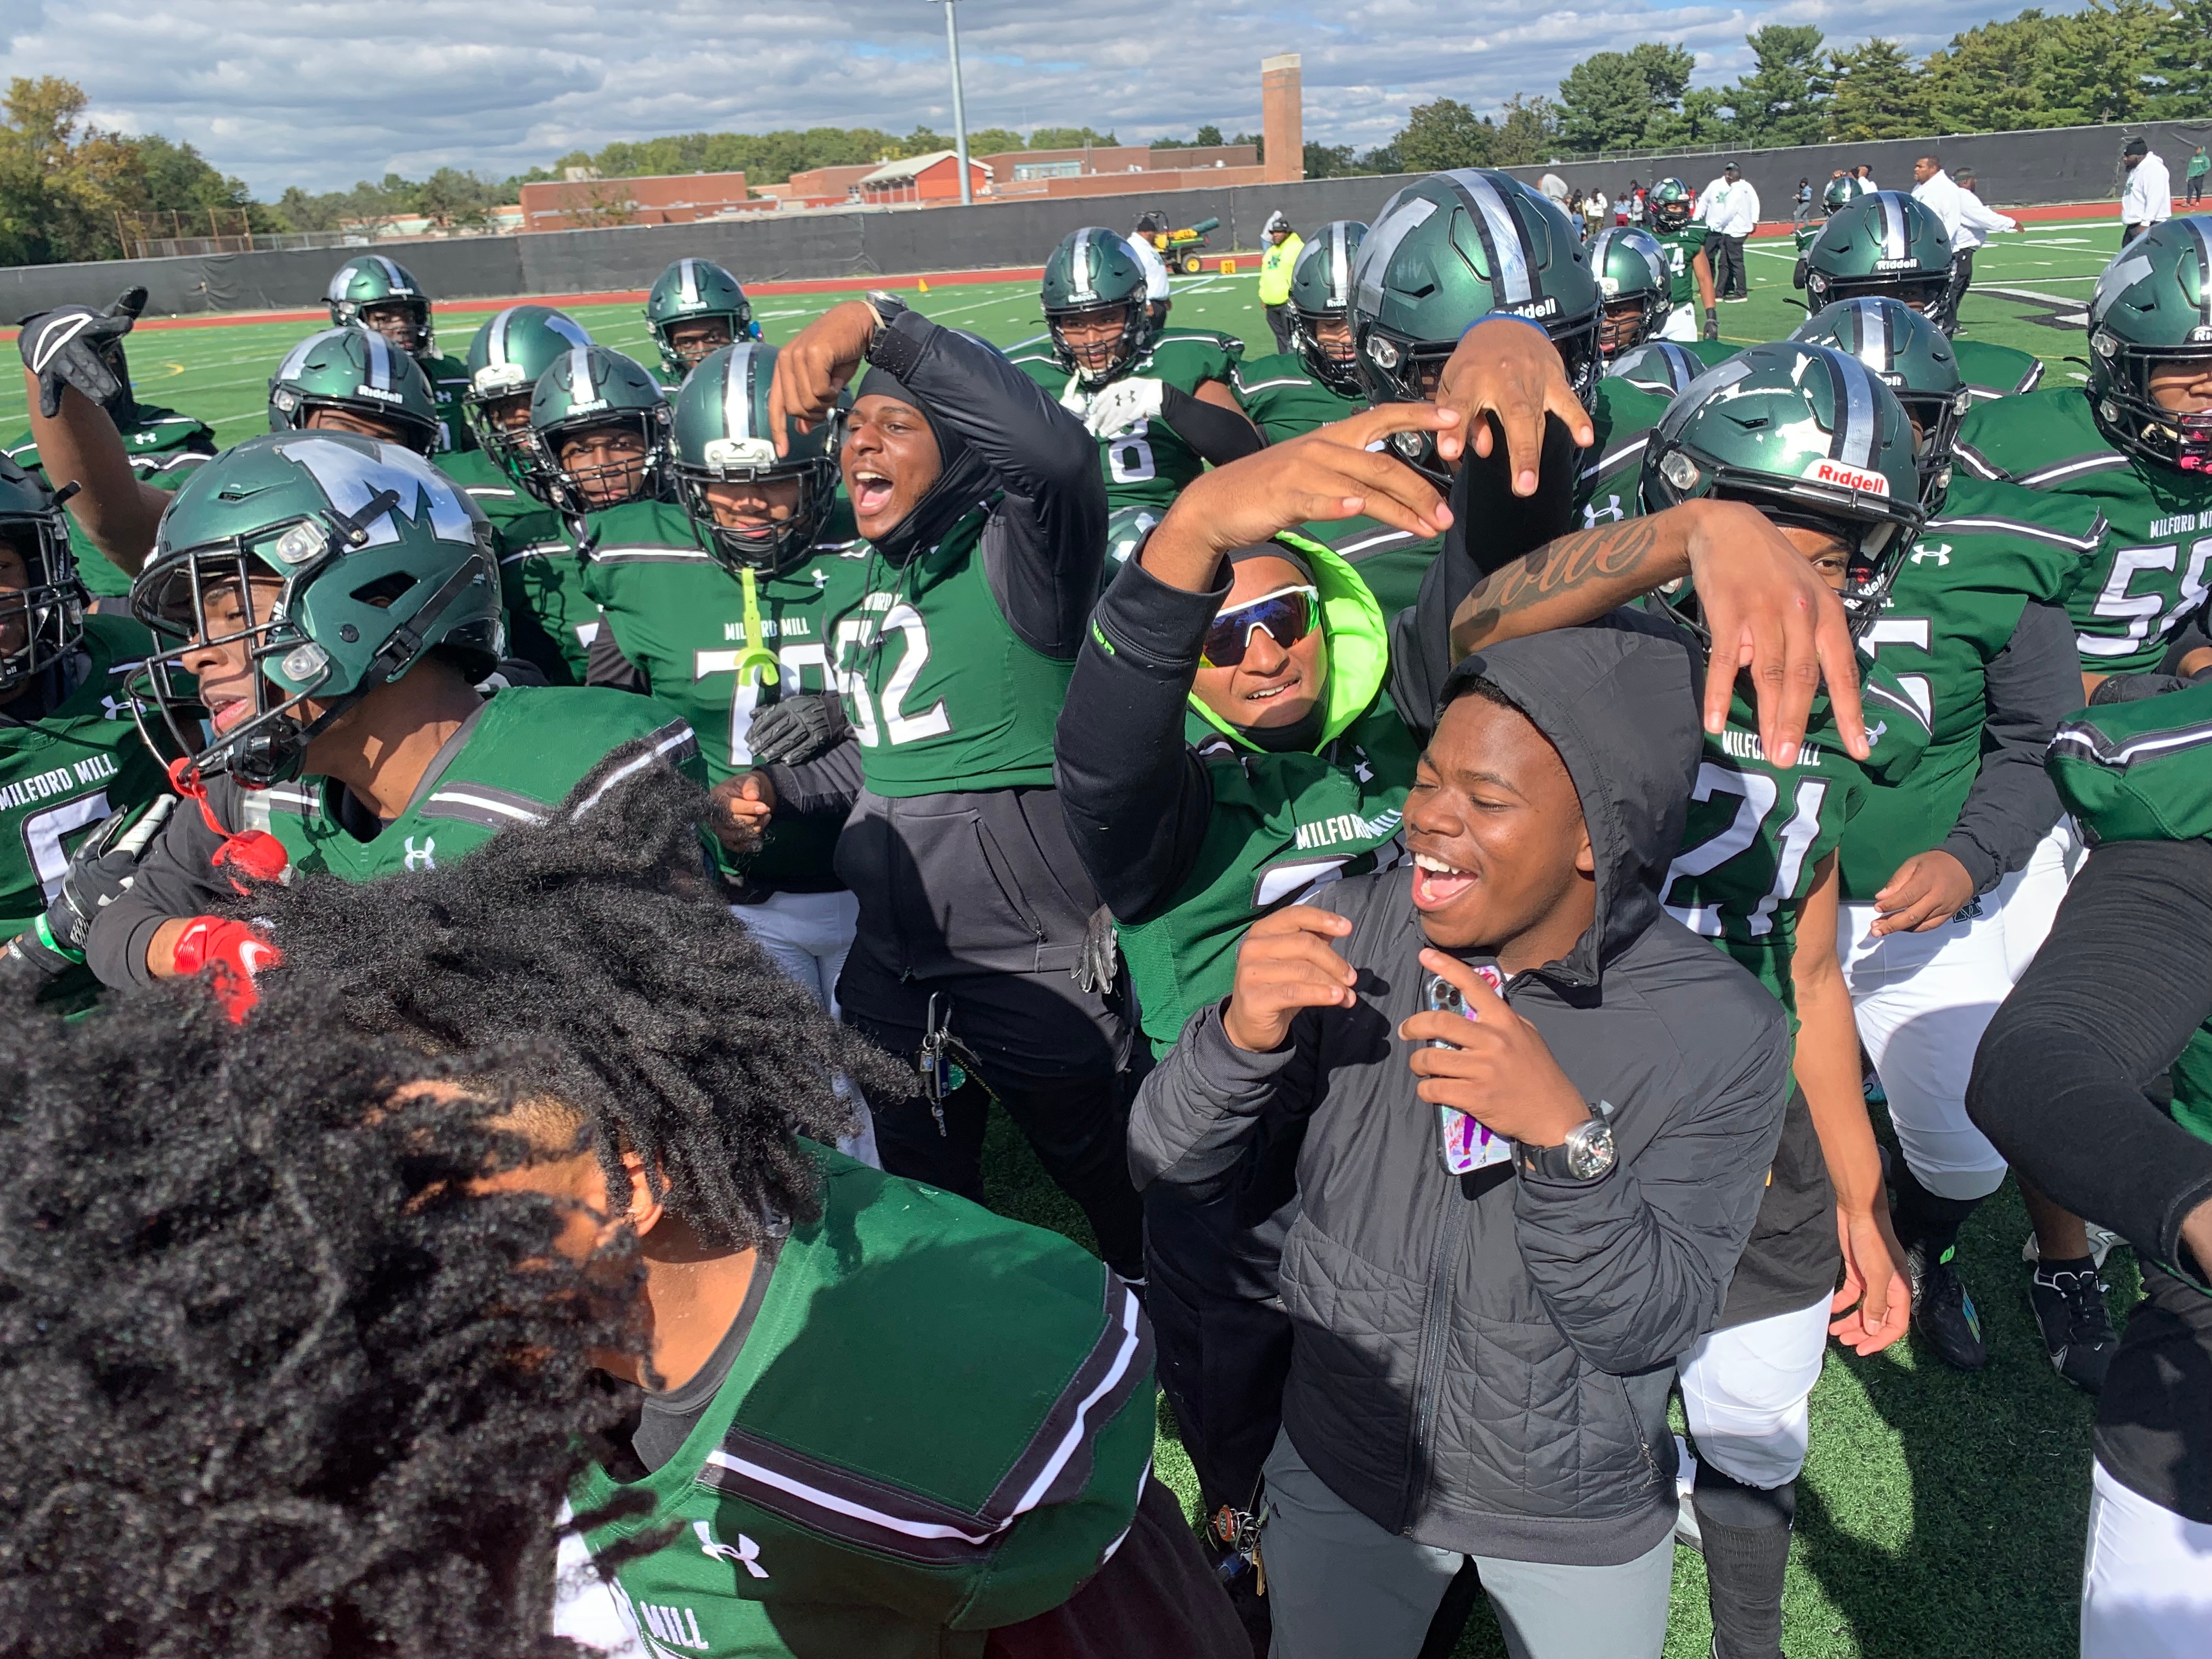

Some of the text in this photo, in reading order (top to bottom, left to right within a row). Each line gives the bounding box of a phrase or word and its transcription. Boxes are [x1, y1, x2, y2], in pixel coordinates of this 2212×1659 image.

[1876, 258, 1917, 270] Riddell
[1326, 297, 1347, 308] Ridd
[1494, 298, 1556, 319] ddell
[358, 385, 403, 404] Riddell
[1818, 465, 1884, 494] Riddell
[2150, 510, 2212, 538] MILFORD MI
[1843, 572, 1886, 610] Rdell
[724, 617, 811, 641] MILRD MILL
[1722, 730, 1821, 766] MILFO ILL
[0, 753, 119, 811] MILFORD MILL
[1295, 813, 1372, 850] MILFORD
[1658, 760, 1826, 937] 21
[7, 943, 21, 960] ONOR
[639, 1600, 709, 1650] MILL
